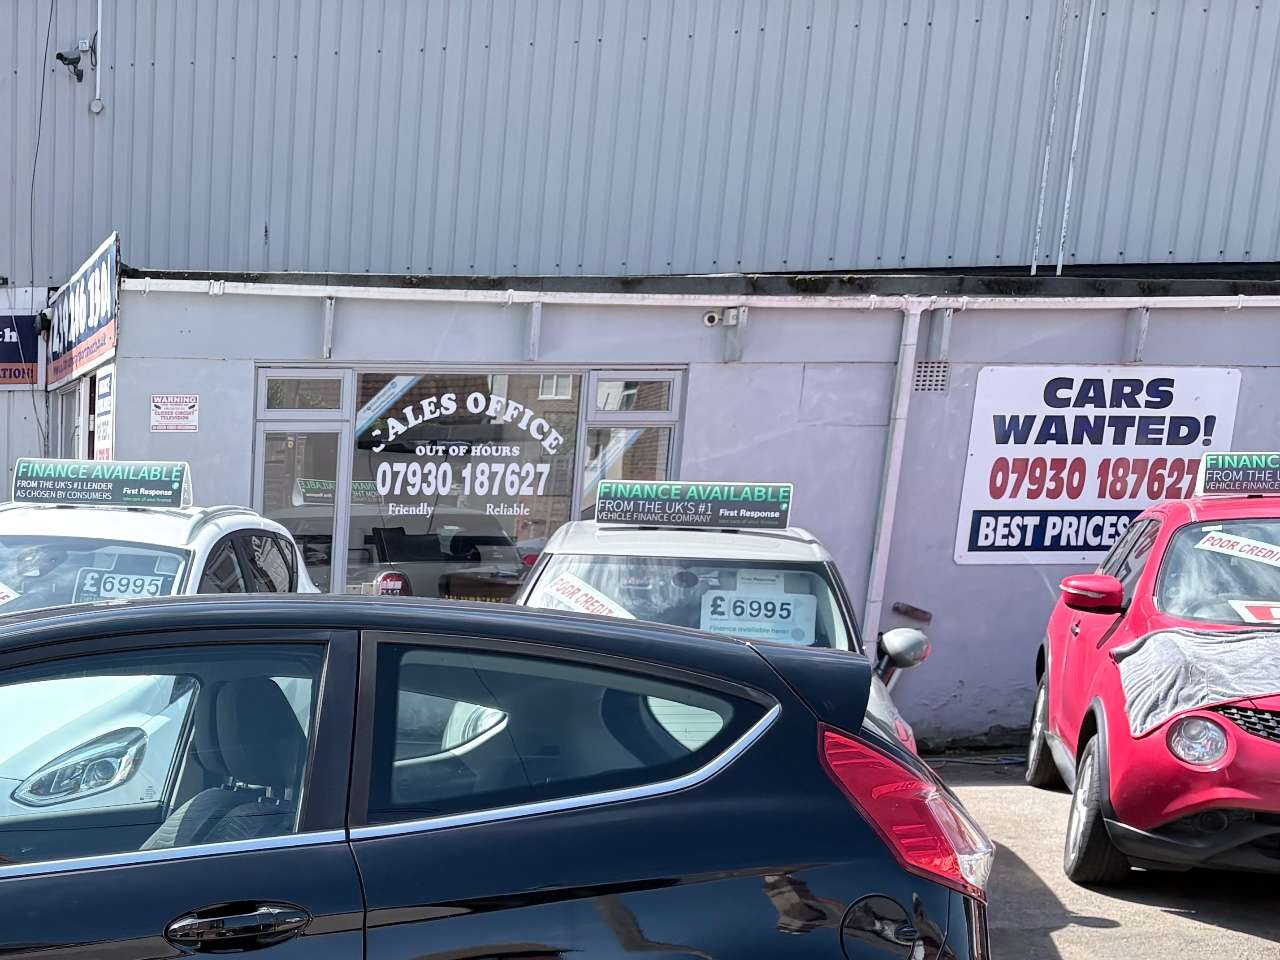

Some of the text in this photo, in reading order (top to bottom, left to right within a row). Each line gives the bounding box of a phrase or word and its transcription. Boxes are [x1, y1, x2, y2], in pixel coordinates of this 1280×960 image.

[1043, 377, 1175, 409] CARS
[466, 391, 563, 455] OFFICE
[992, 415, 1217, 447] WANTED!
[416, 445, 521, 457] OUT OF HOURS
[1206, 455, 1280, 469] FINANC
[18, 463, 182, 481] FINANCE AVAILABLE
[376, 462, 550, 496] 07930 187627
[989, 456, 1201, 500] 07930 187627
[1206, 470, 1271, 481] FROM THE
[16, 480, 113, 490] FROM THE UK'S #1 LENDER
[123, 487, 173, 497] First Response
[600, 483, 790, 502] FINANCE AVAILABLE
[1205, 481, 1241, 490] VEHICLE
[16, 490, 25, 498] AS
[26, 490, 56, 498] CHOSEN
[67, 491, 112, 499] CONSUMERS
[388, 503, 434, 518] Friendly
[486, 503, 530, 516] Reliable
[598, 500, 712, 514] FROM THE UK'S #1
[719, 509, 780, 519] First Response
[598, 512, 631, 521] VEHICLE
[633, 512, 669, 522] FINANCE
[670, 513, 712, 522] COMPANY
[977, 516, 1041, 546] BEST
[1043, 516, 1131, 546] PRICES
[1202, 536, 1240, 551] POOR
[83, 572, 160, 596] £6995
[551, 578, 581, 599] POOR
